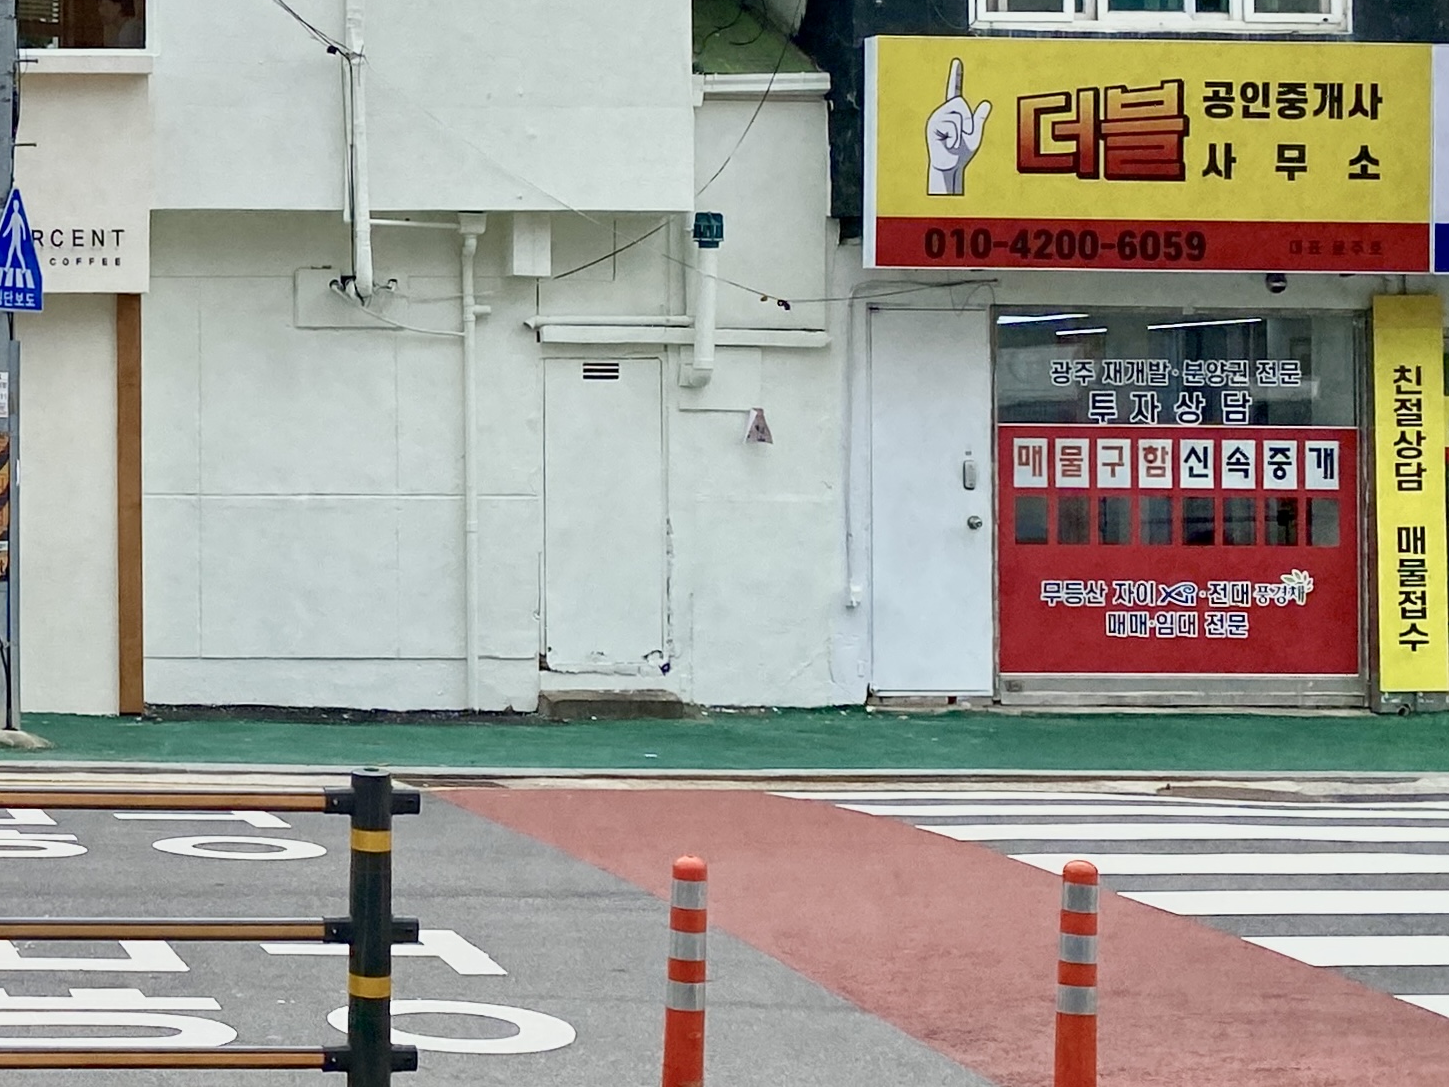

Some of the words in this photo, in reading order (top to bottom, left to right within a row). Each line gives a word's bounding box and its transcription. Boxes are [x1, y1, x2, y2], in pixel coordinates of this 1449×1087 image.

[1202, 80, 1383, 121] 공인중개사
[1016, 78, 1190, 182] 더블
[49, 257, 121, 266] COFFEE
[924, 227, 1207, 262] 010-4200-6059
[1050, 359, 1095, 386] 광주
[1255, 360, 1302, 387] 전문
[1392, 364, 1426, 492] 친절상담
[1040, 580, 1107, 606] 무등산
[1396, 525, 1430, 653] 매물접수
[1204, 612, 1249, 638] 전문
